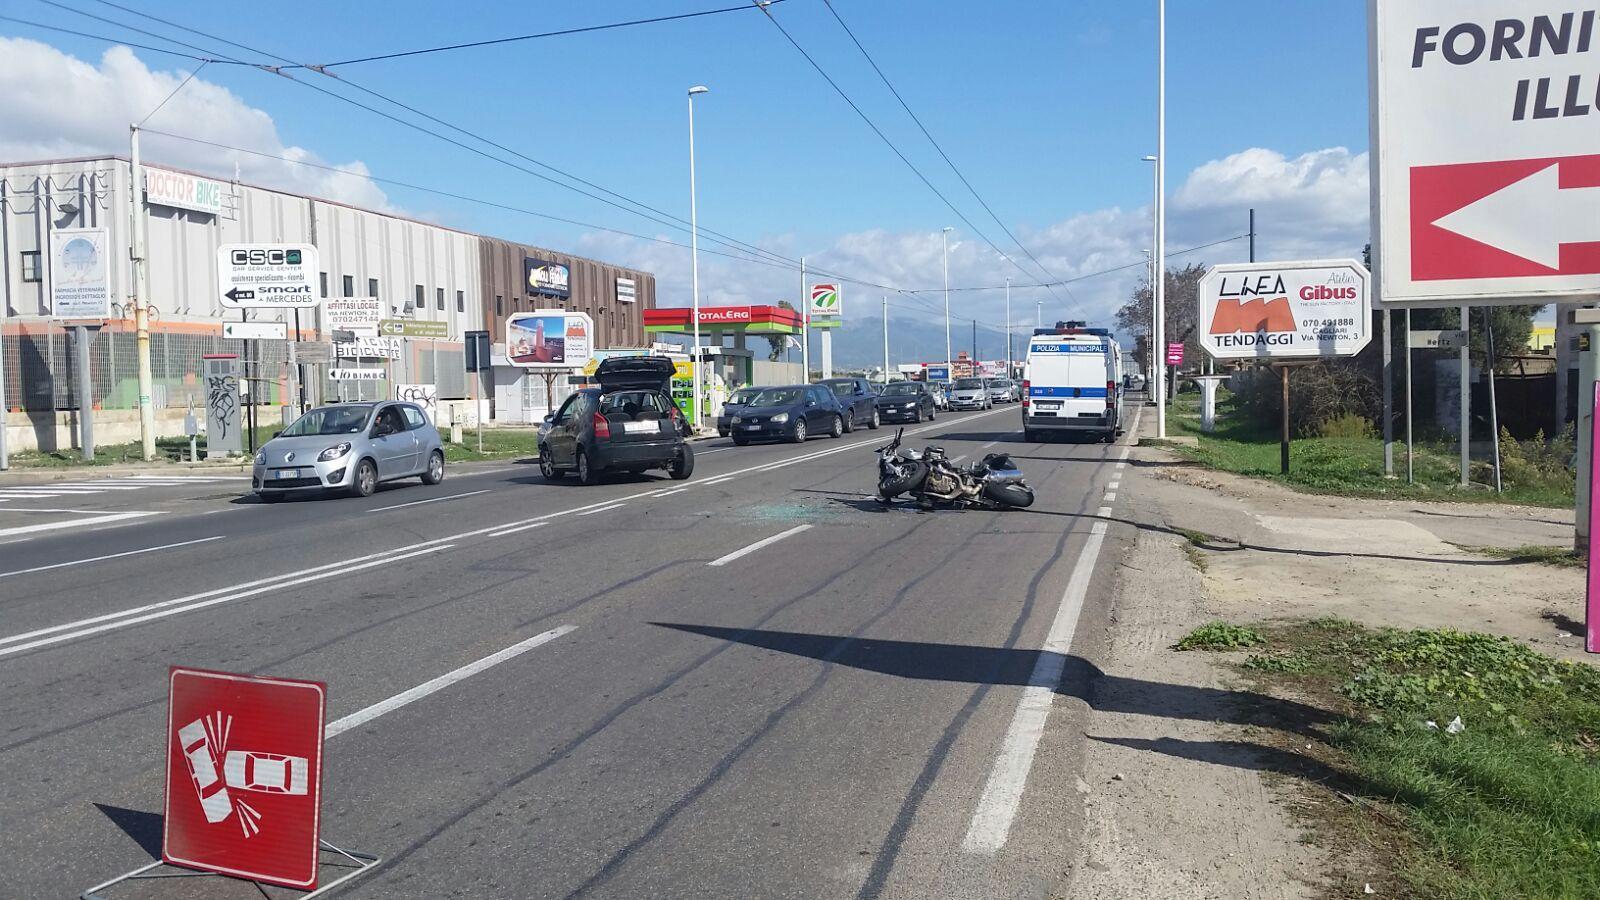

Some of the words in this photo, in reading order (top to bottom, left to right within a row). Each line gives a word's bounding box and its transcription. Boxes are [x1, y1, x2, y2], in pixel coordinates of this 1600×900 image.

[1512, 73, 1600, 121] ILL
[149, 171, 193, 202] DOCTOR
[196, 181, 220, 207] BIKE
[287, 273, 305, 281] ricambi
[258, 285, 311, 293] smart
[1299, 285, 1357, 301] Gibus
[266, 295, 312, 303] MERCEDES
[1302, 318, 1354, 327] 070.491888
[1214, 334, 1293, 347] TENDAGGI
[1353, 332, 1359, 340] 3
